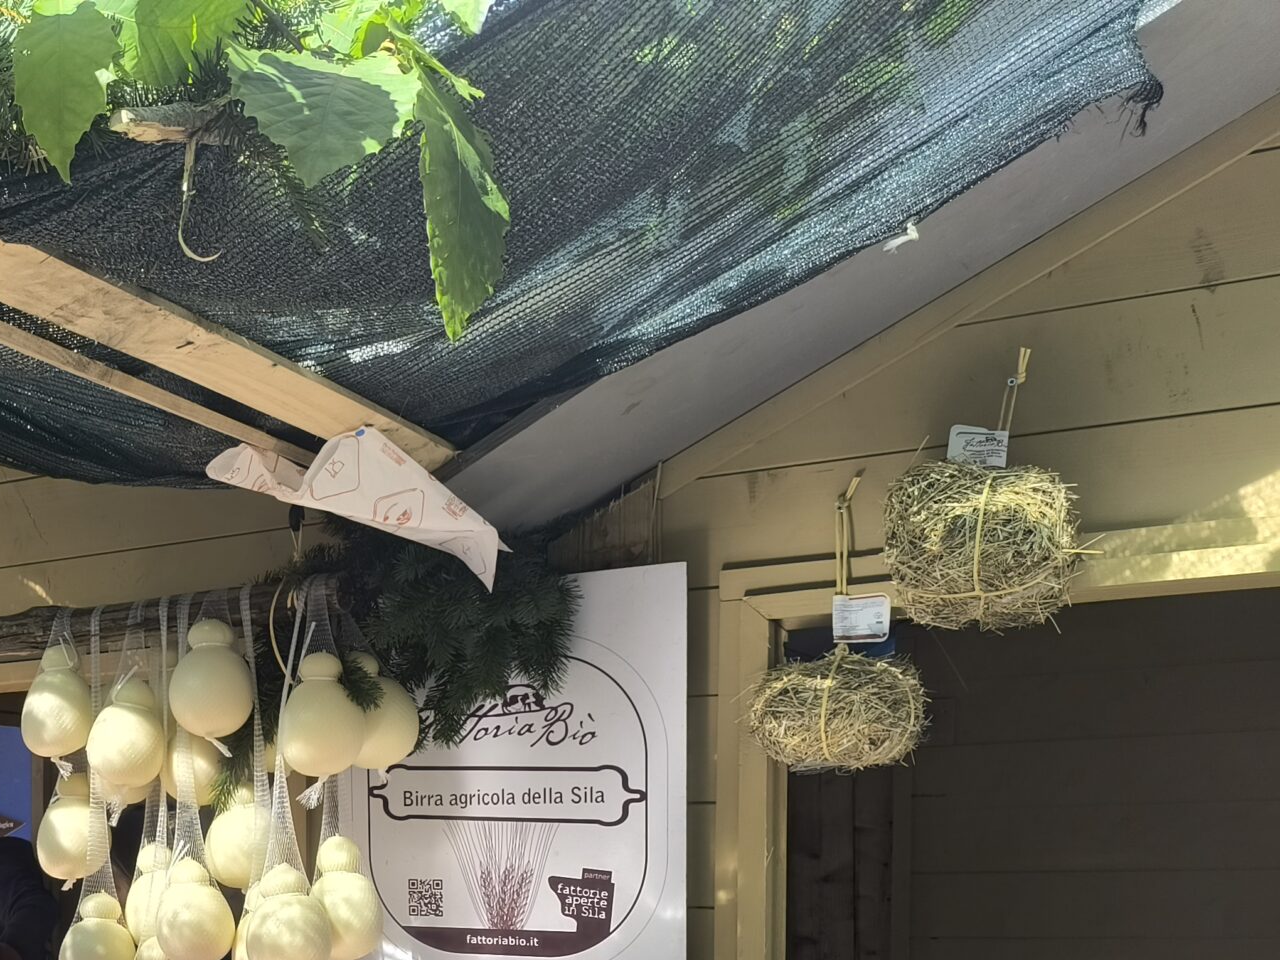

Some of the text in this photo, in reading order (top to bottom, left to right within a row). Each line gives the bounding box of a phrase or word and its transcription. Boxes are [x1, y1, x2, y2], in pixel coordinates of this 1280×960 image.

[403, 785, 605, 809] Birra agricola della Sila
[583, 871, 611, 881] partner
[557, 882, 609, 900] fattorie
[565, 895, 608, 909] aperte
[564, 905, 606, 919] in Sila
[466, 934, 540, 947] fattoriabio.it
